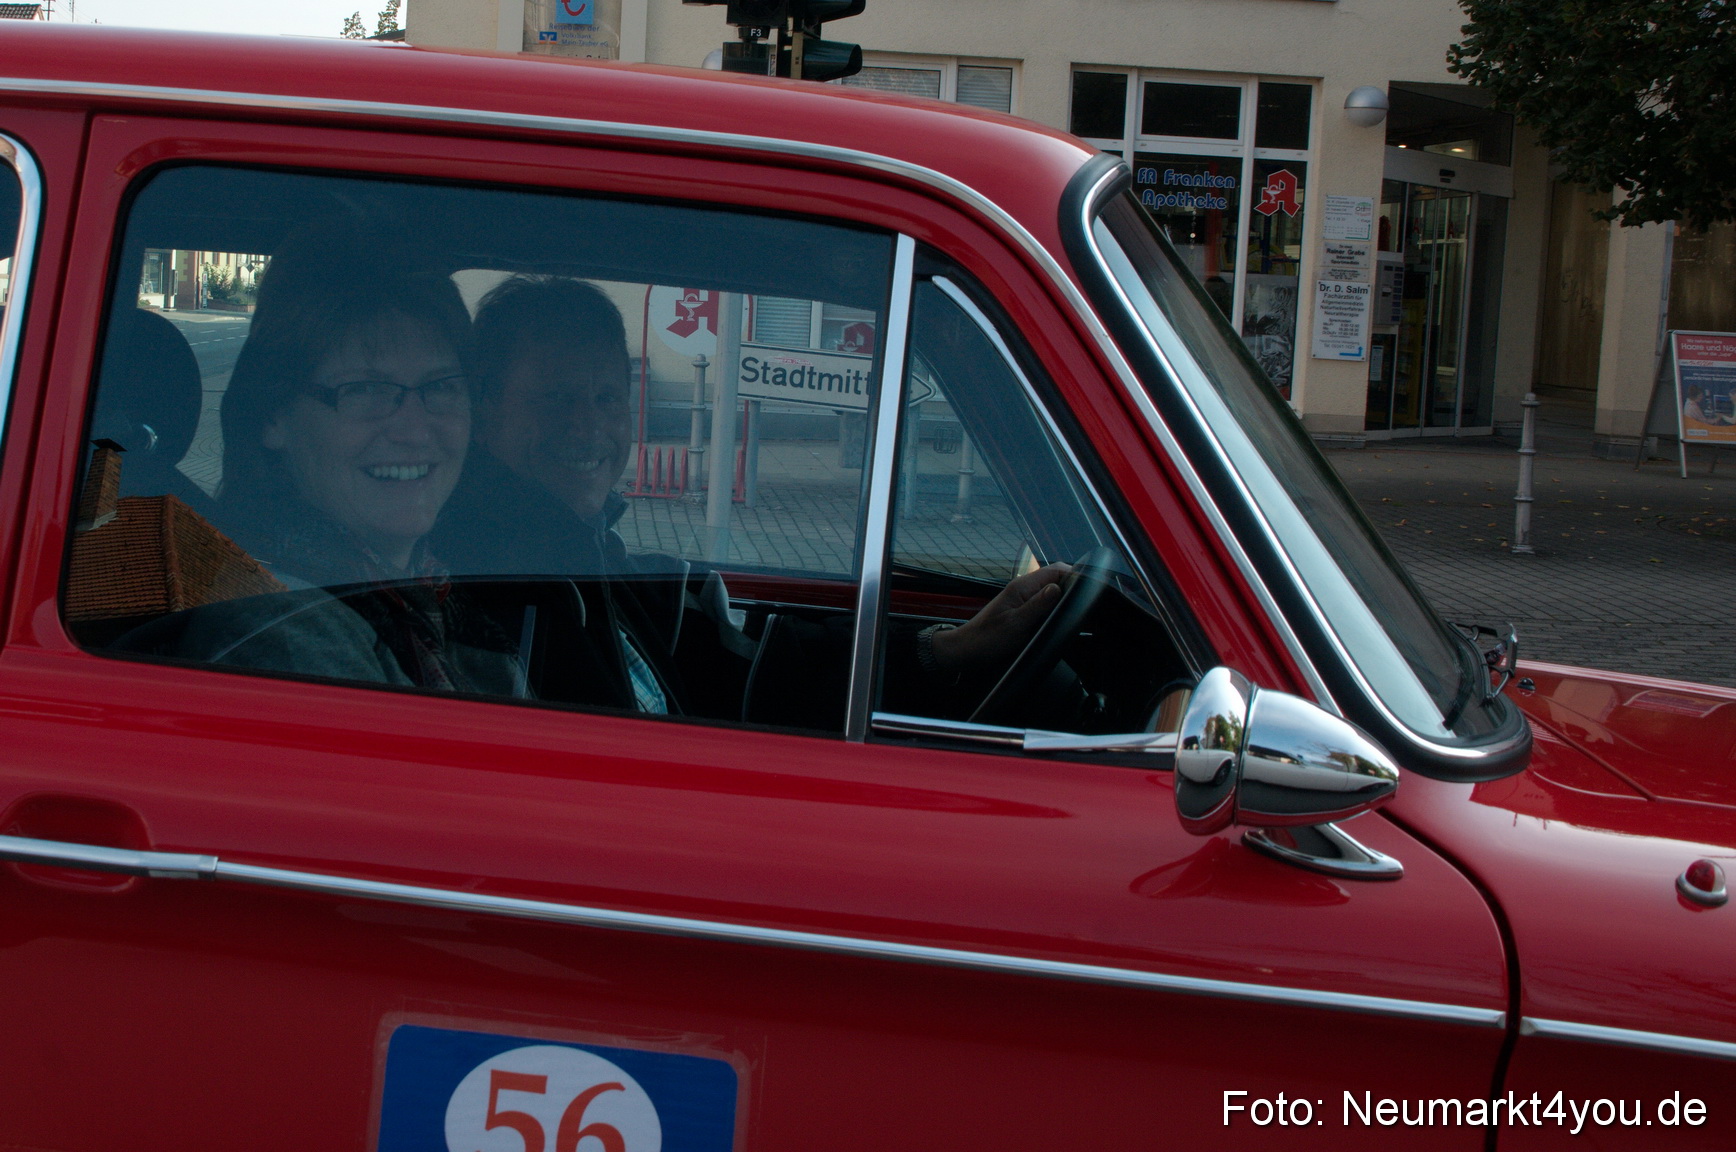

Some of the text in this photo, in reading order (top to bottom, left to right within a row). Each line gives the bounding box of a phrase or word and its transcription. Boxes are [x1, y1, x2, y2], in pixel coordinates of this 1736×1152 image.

[751, 28, 762, 37] F3
[1163, 169, 1236, 189] Franken
[1142, 189, 1228, 210] Apotheke
[1319, 283, 1369, 294] Dr. D. Salm
[1323, 292, 1354, 300] Fachärztin
[741, 356, 873, 396] Stadtmitt
[475, 1069, 626, 1152] 56
